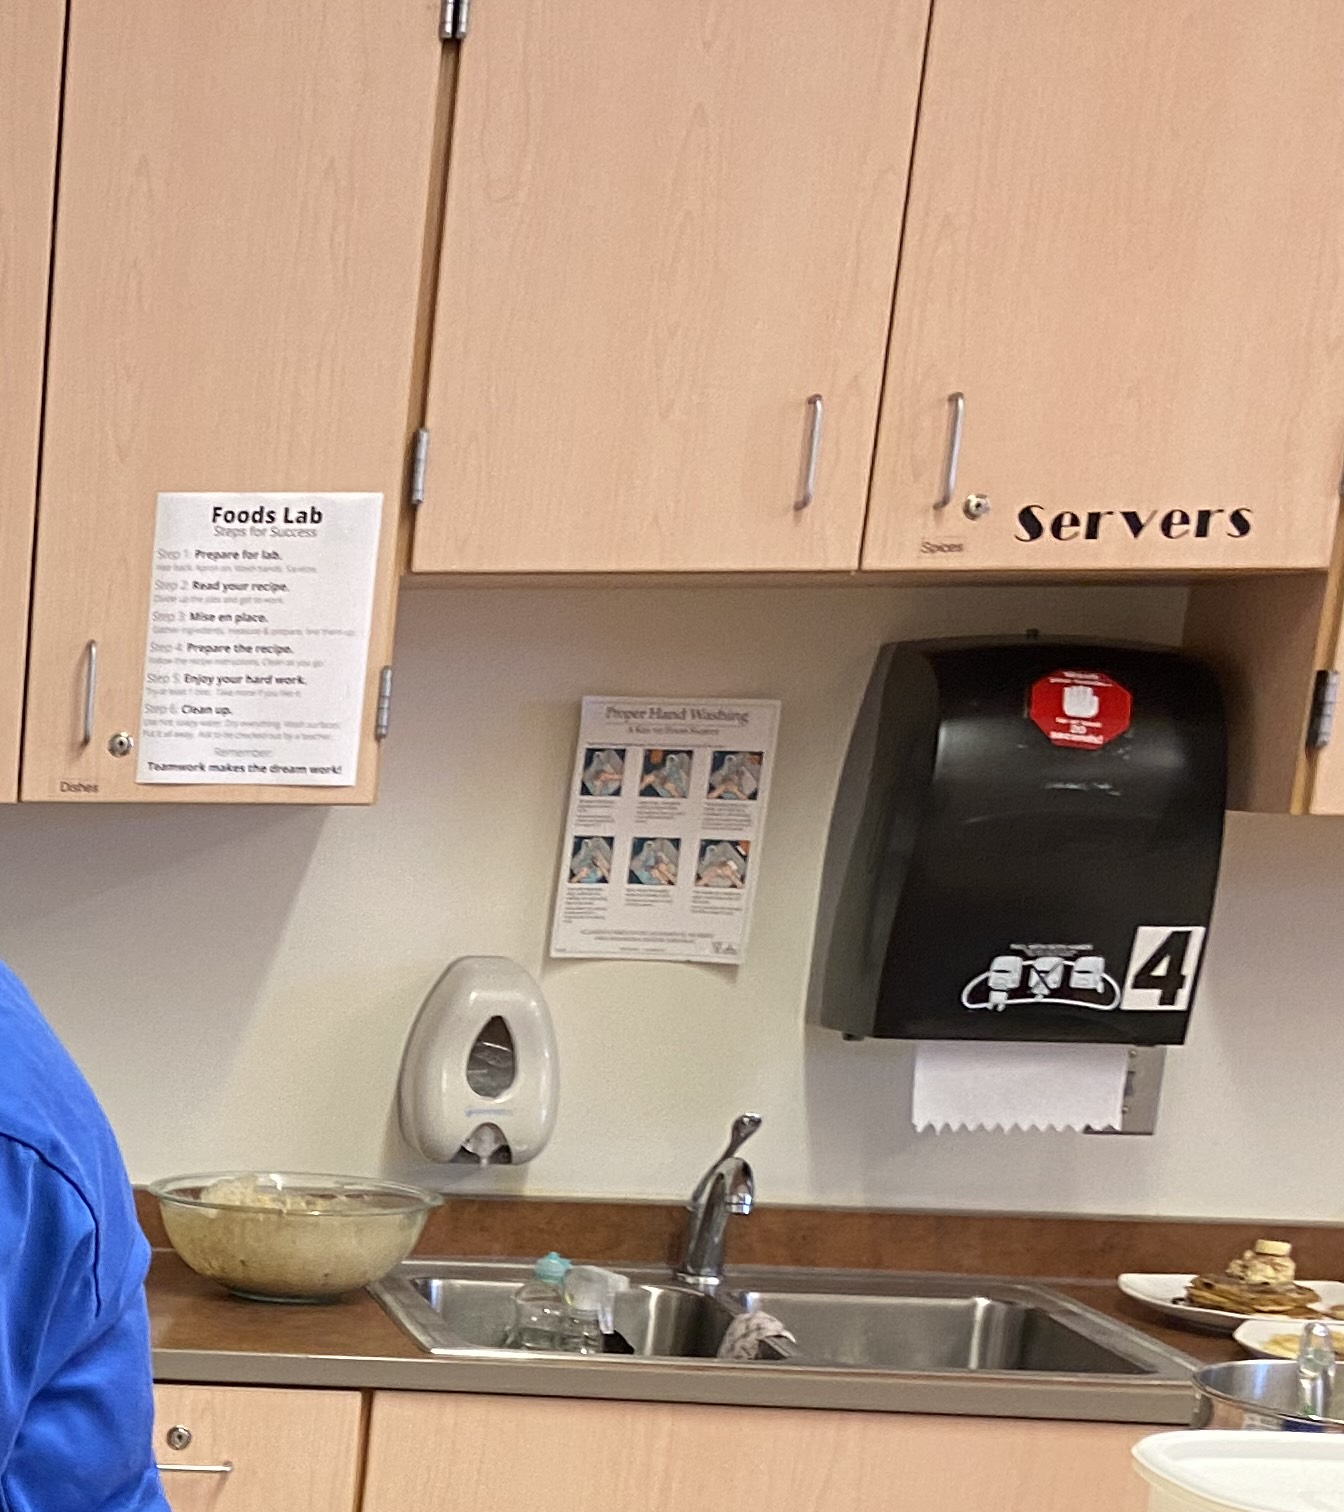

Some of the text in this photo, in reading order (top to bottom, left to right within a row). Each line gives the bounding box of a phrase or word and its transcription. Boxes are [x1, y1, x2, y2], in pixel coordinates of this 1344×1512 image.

[211, 505, 323, 524] Foods Lab
[1014, 504, 1253, 542] Servers
[194, 549, 240, 561] Prepare
[242, 549, 260, 560] for
[192, 580, 221, 591] Read
[222, 582, 250, 594] your
[189, 611, 216, 622] Mise
[218, 614, 233, 622] en
[186, 642, 232, 655] Prepare
[233, 643, 253, 653] the
[184, 672, 215, 686] Enjoy
[216, 675, 243, 687] your
[244, 673, 273, 684] hard
[181, 703, 213, 715] Clean
[605, 706, 750, 726] Proper Hand Washing
[147, 761, 207, 773] Teamwork
[207, 763, 246, 773] makes
[247, 763, 268, 773] the
[269, 763, 307, 774] dream
[1131, 931, 1194, 1008] 4
